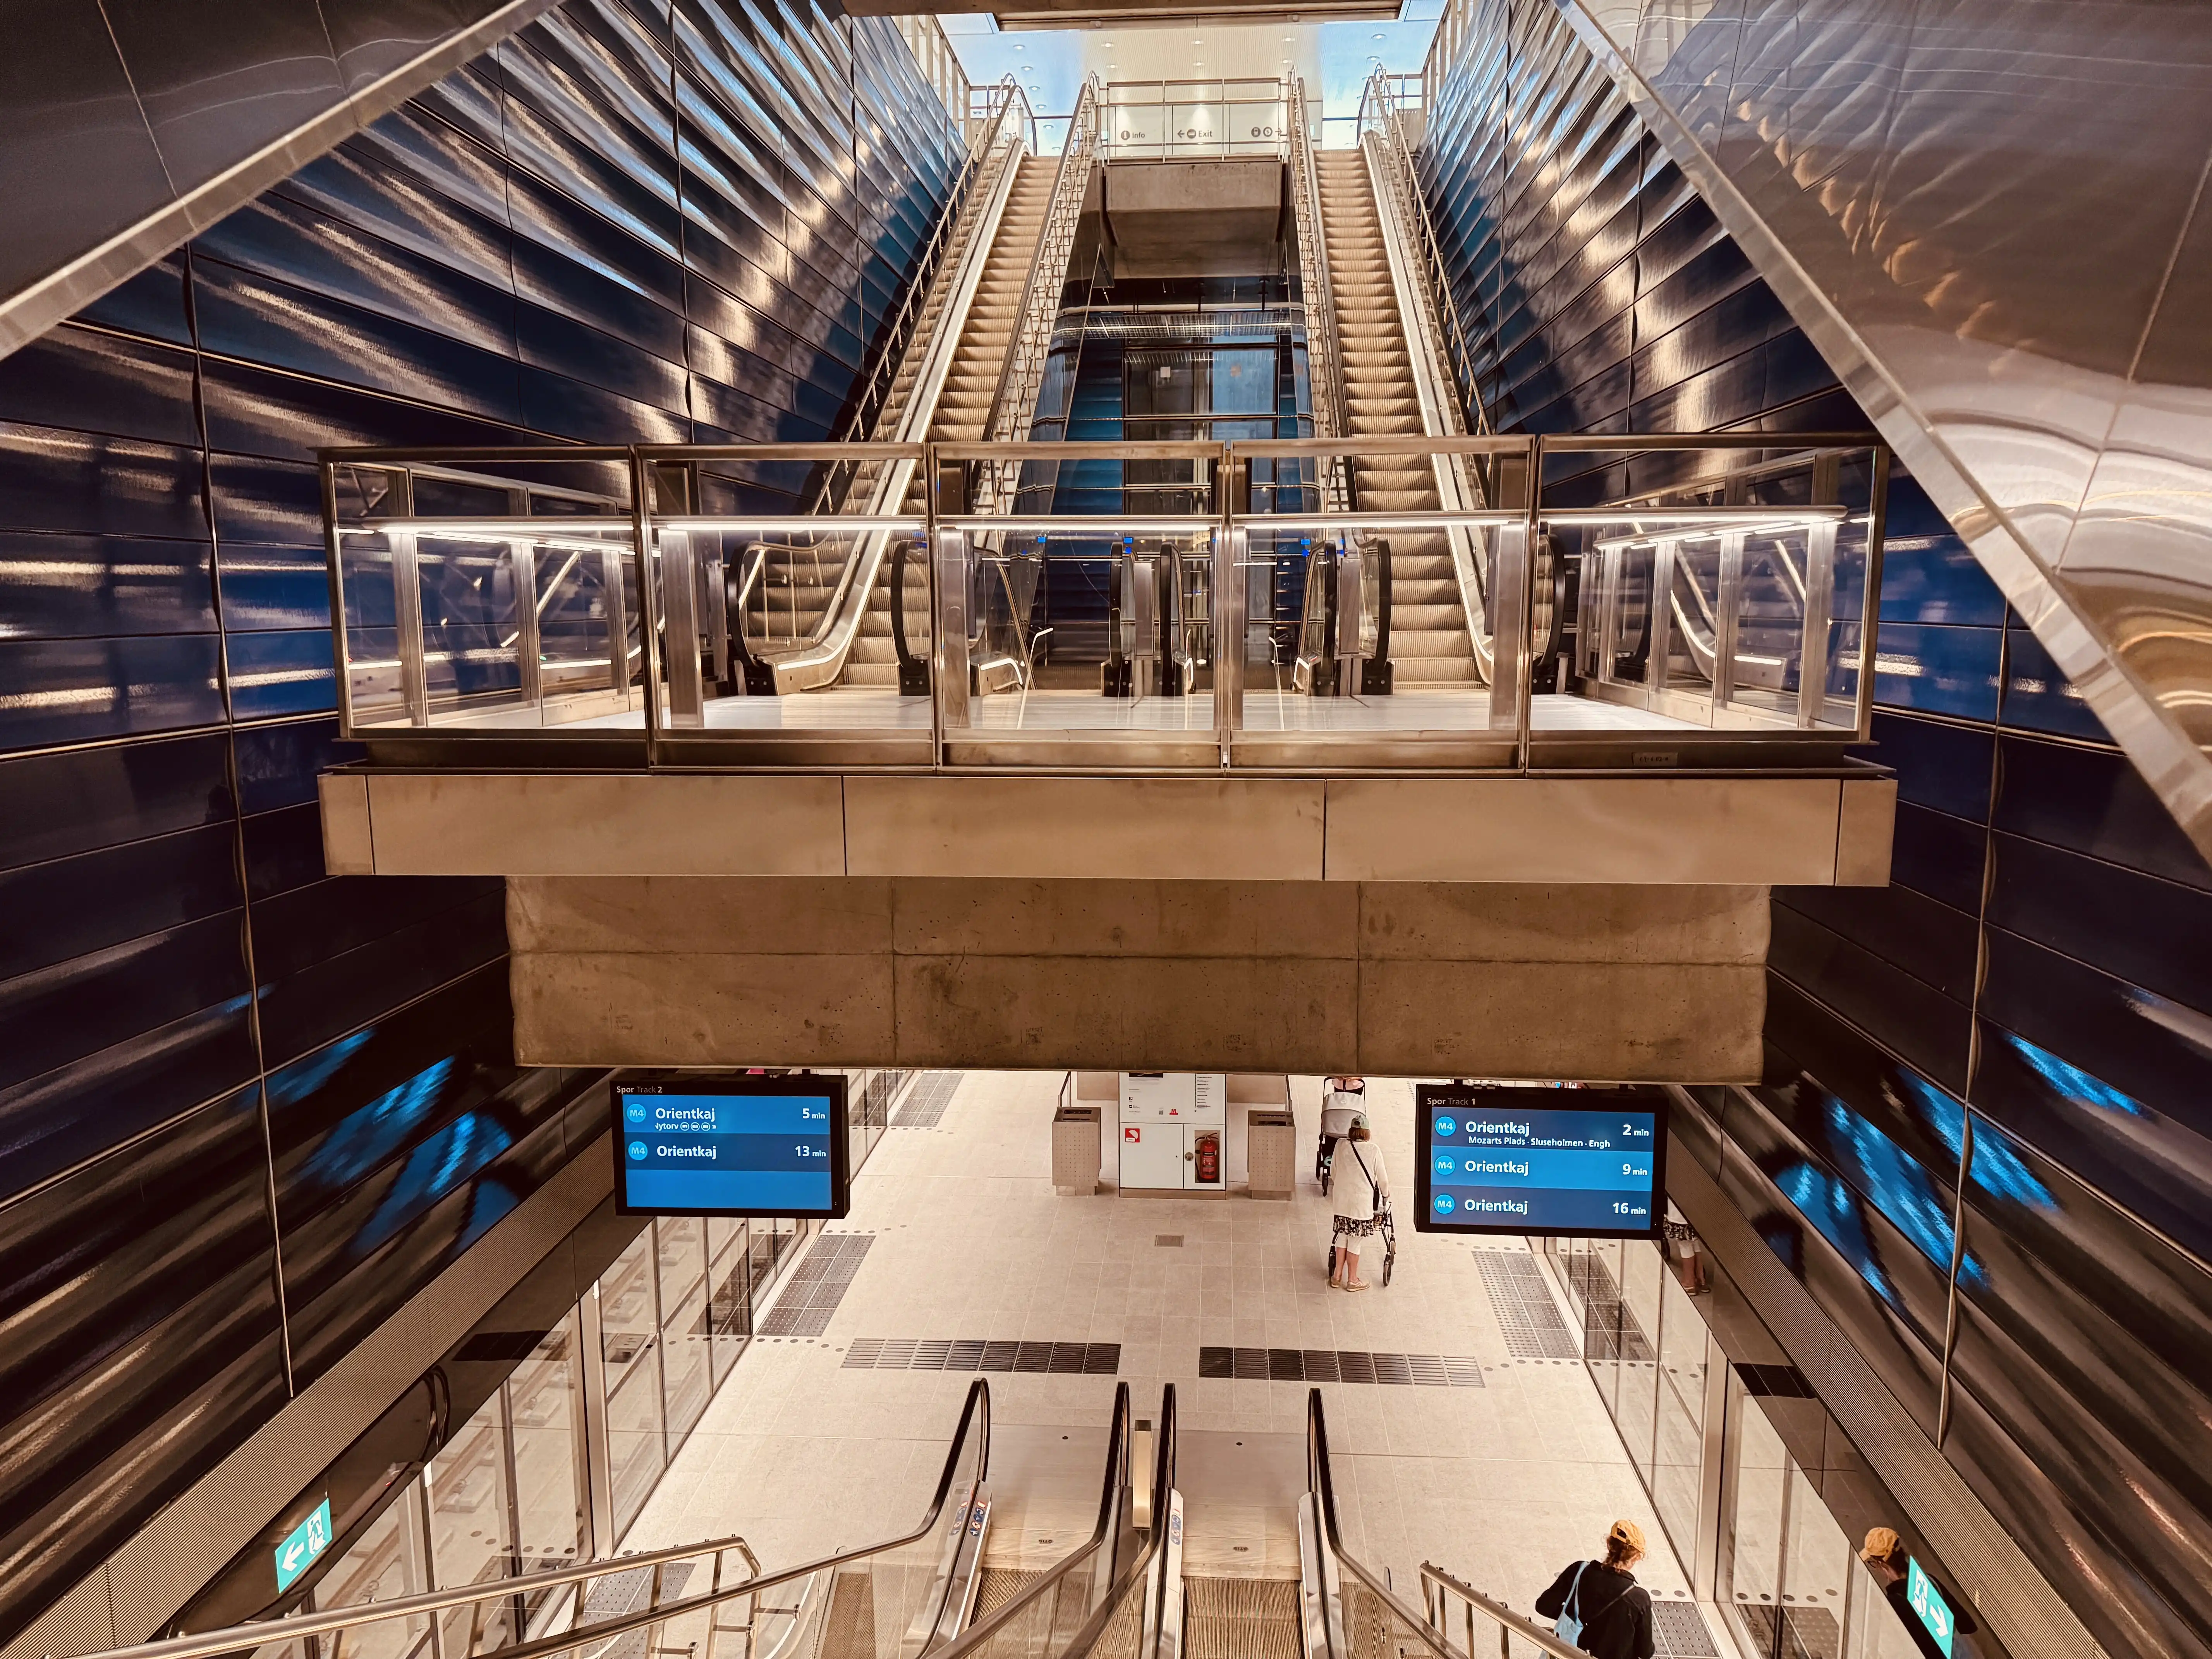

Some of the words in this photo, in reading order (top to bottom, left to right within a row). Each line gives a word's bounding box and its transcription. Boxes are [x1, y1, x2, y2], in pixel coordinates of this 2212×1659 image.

[1427, 1097, 1446, 1106] Spor
[655, 1108, 715, 1122] Orientkaj
[803, 1108, 810, 1119] 5
[1438, 1122, 1453, 1130] M4
[1466, 1121, 1529, 1137] Orientkaj
[1623, 1124, 1631, 1135] 2
[1468, 1136, 1502, 1144] Mozarts
[1504, 1137, 1525, 1145] Plads
[1531, 1138, 1583, 1147] Sluseholmen
[1589, 1140, 1610, 1149] Engh
[657, 1146, 716, 1160] Orientkaj
[795, 1146, 810, 1156] 13
[1465, 1160, 1528, 1176] Orientkaj
[1623, 1163, 1631, 1175] 9
[1465, 1199, 1528, 1215] Orientkaj
[1613, 1202, 1629, 1214] 16
